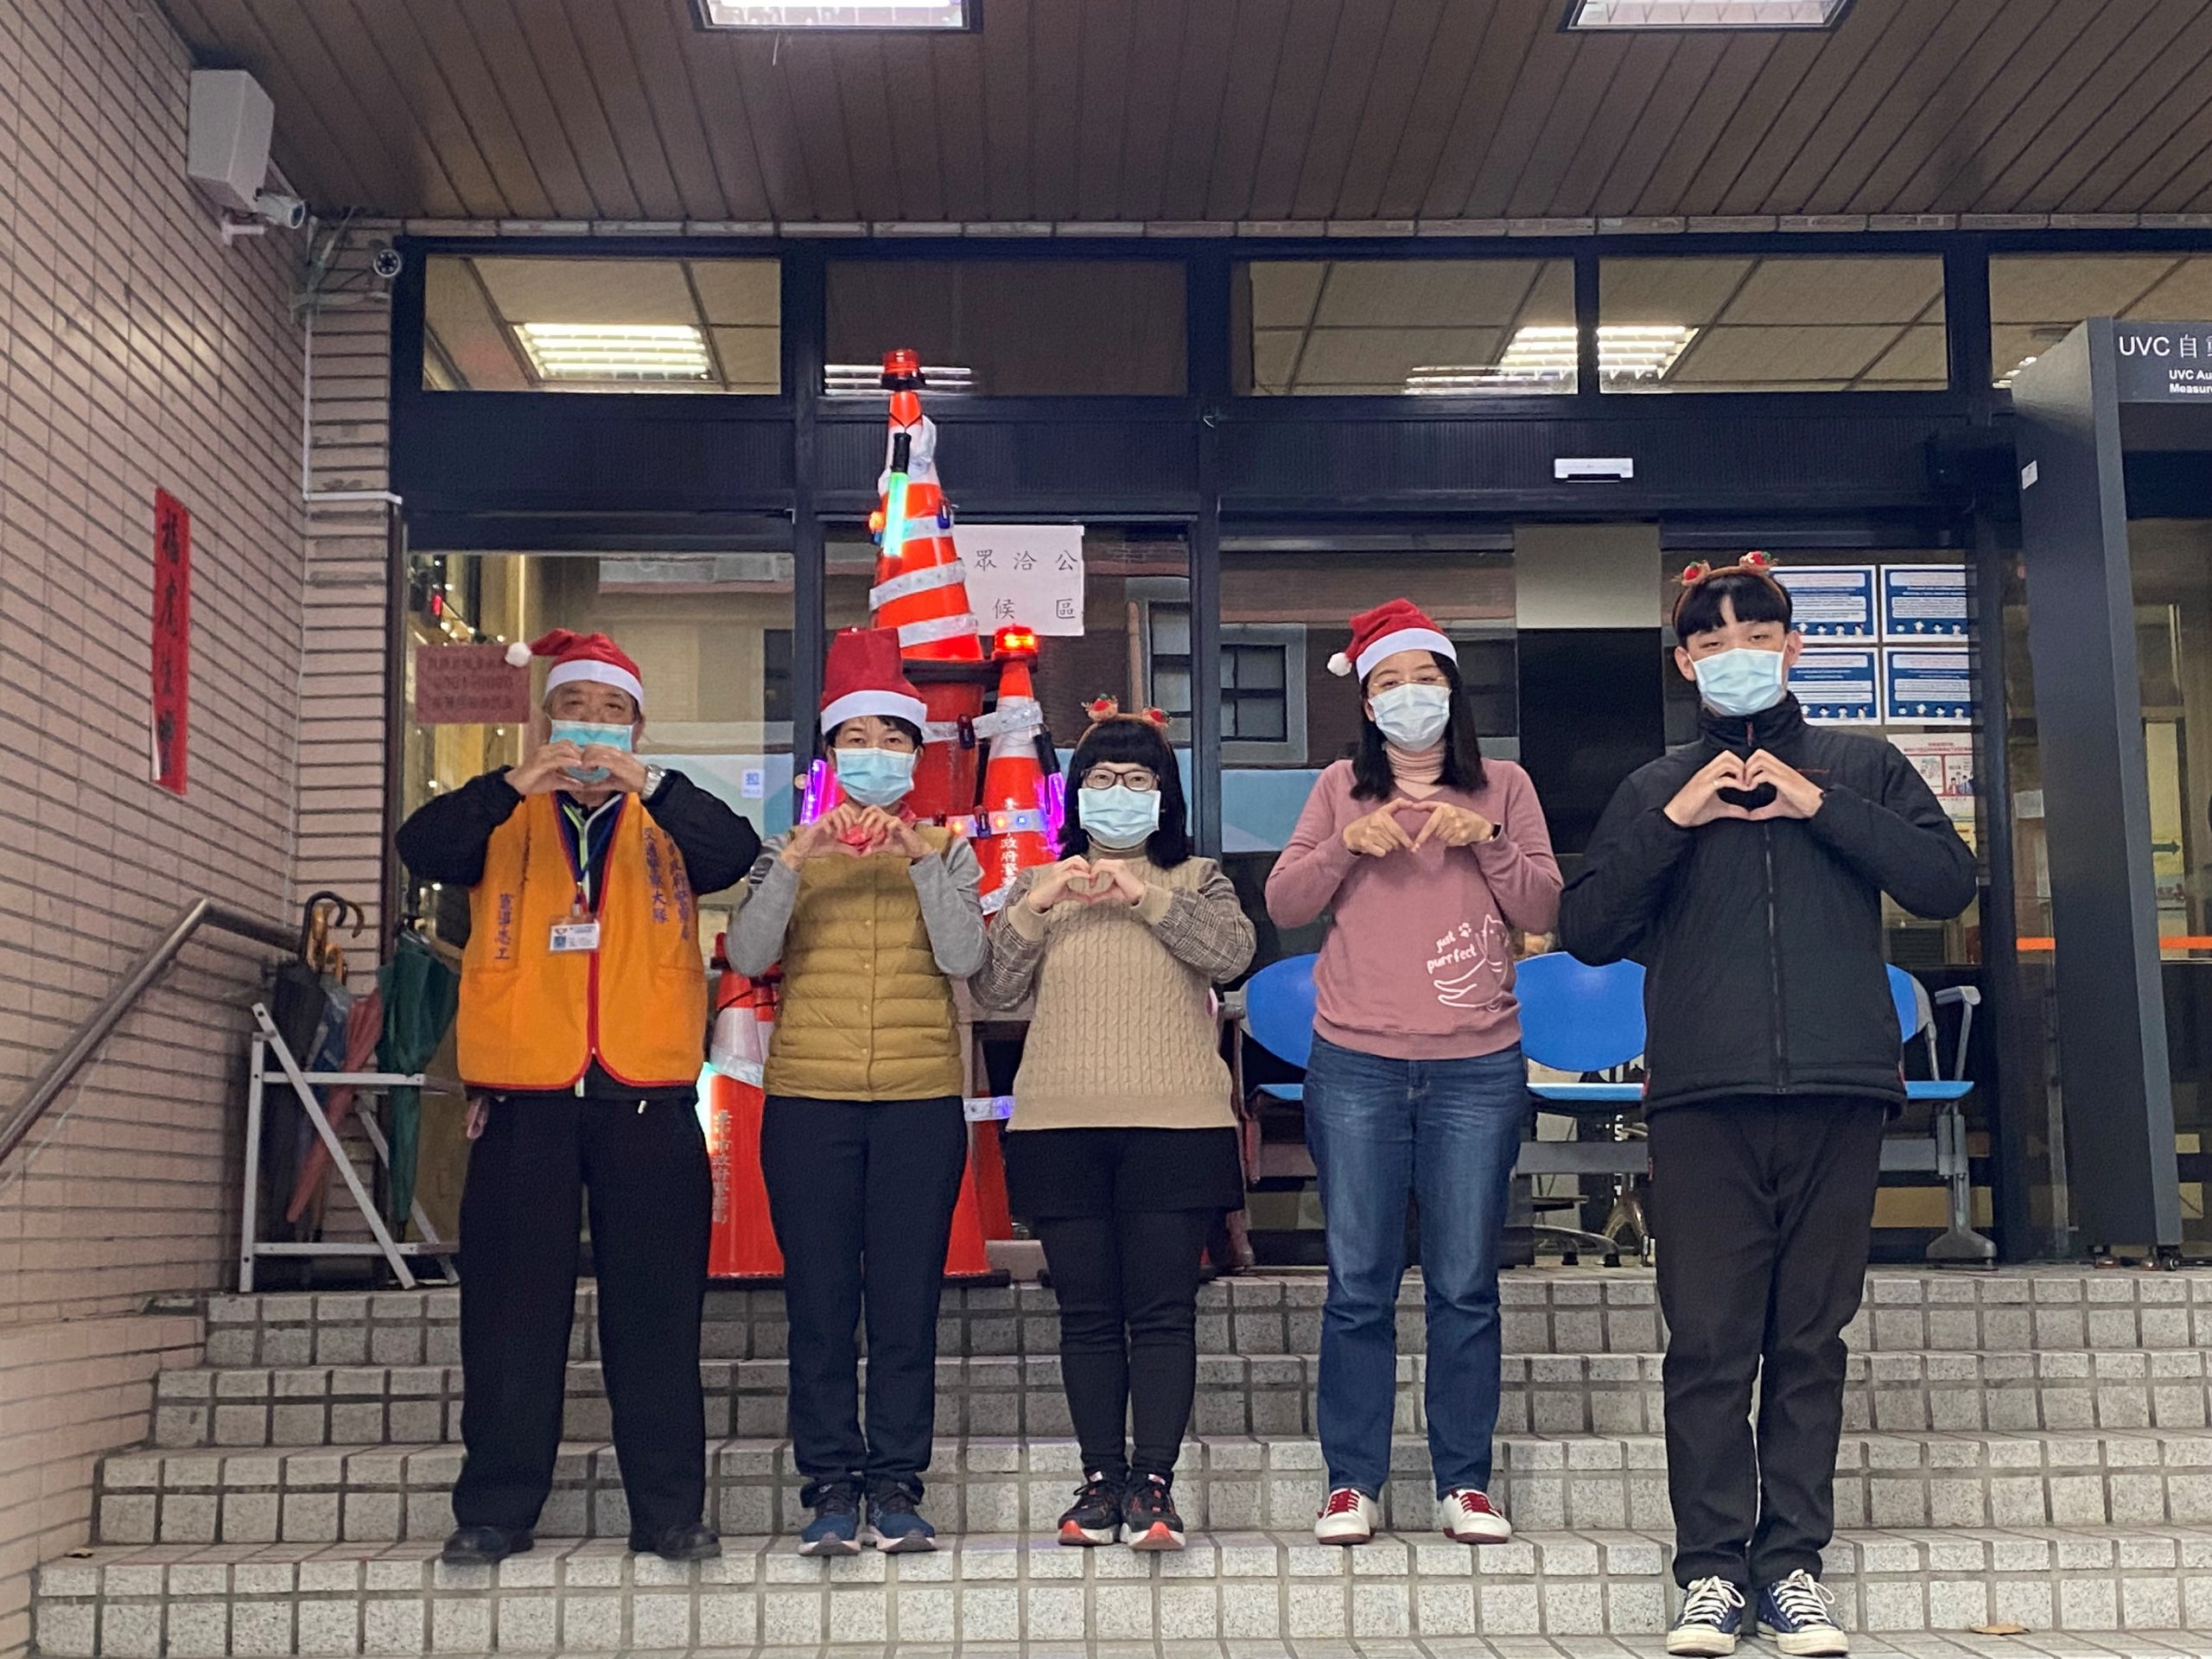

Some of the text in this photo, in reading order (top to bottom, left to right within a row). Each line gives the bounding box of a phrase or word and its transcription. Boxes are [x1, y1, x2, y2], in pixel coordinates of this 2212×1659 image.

[2119, 336, 2171, 356] UVC
[2169, 370, 2194, 380] UVC
[975, 549, 1078, 572] 眾洽公
[994, 597, 1076, 620] 候 區
[1427, 944, 1477, 975] purrfect
